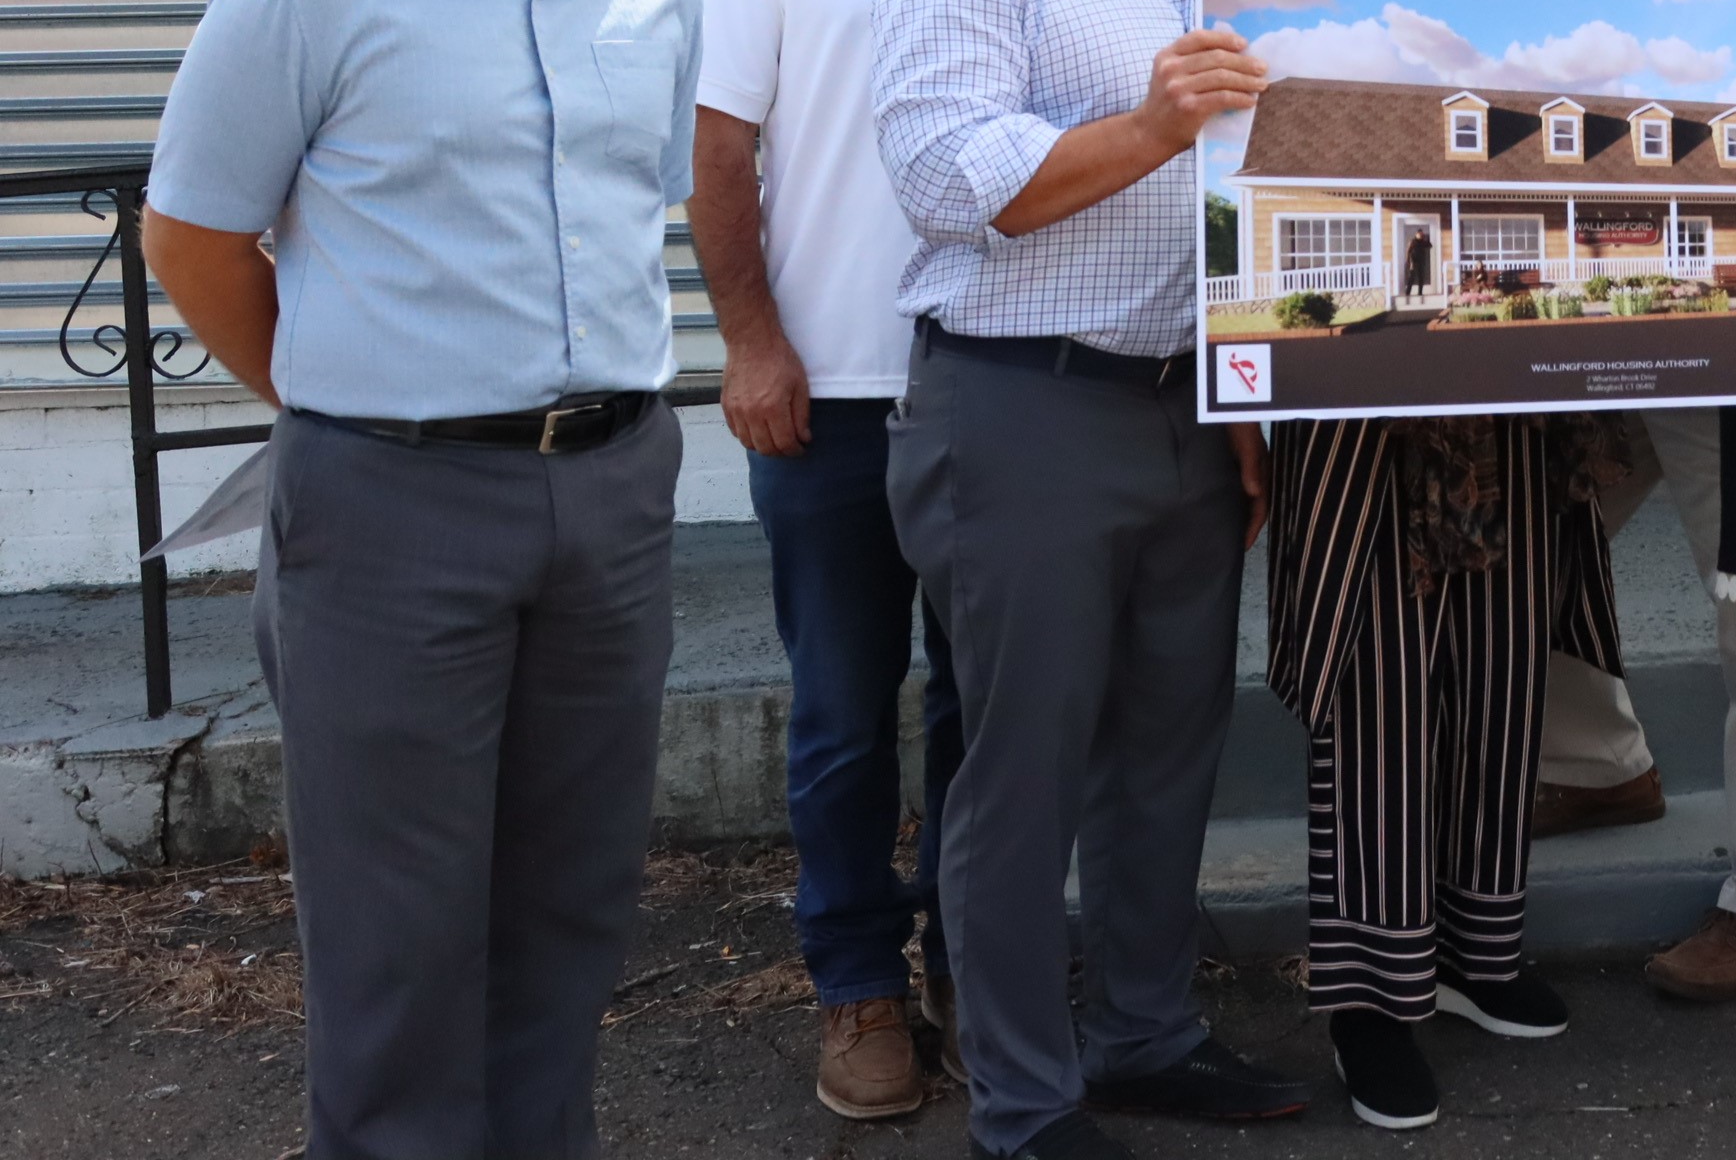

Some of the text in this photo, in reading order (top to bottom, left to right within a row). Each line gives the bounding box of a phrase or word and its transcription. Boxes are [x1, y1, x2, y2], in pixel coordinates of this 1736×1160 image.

[1574, 222, 1653, 231] WALLINGFORD
[1531, 358, 1710, 373] WALLINGFORD HOUSING AUTHORITY
